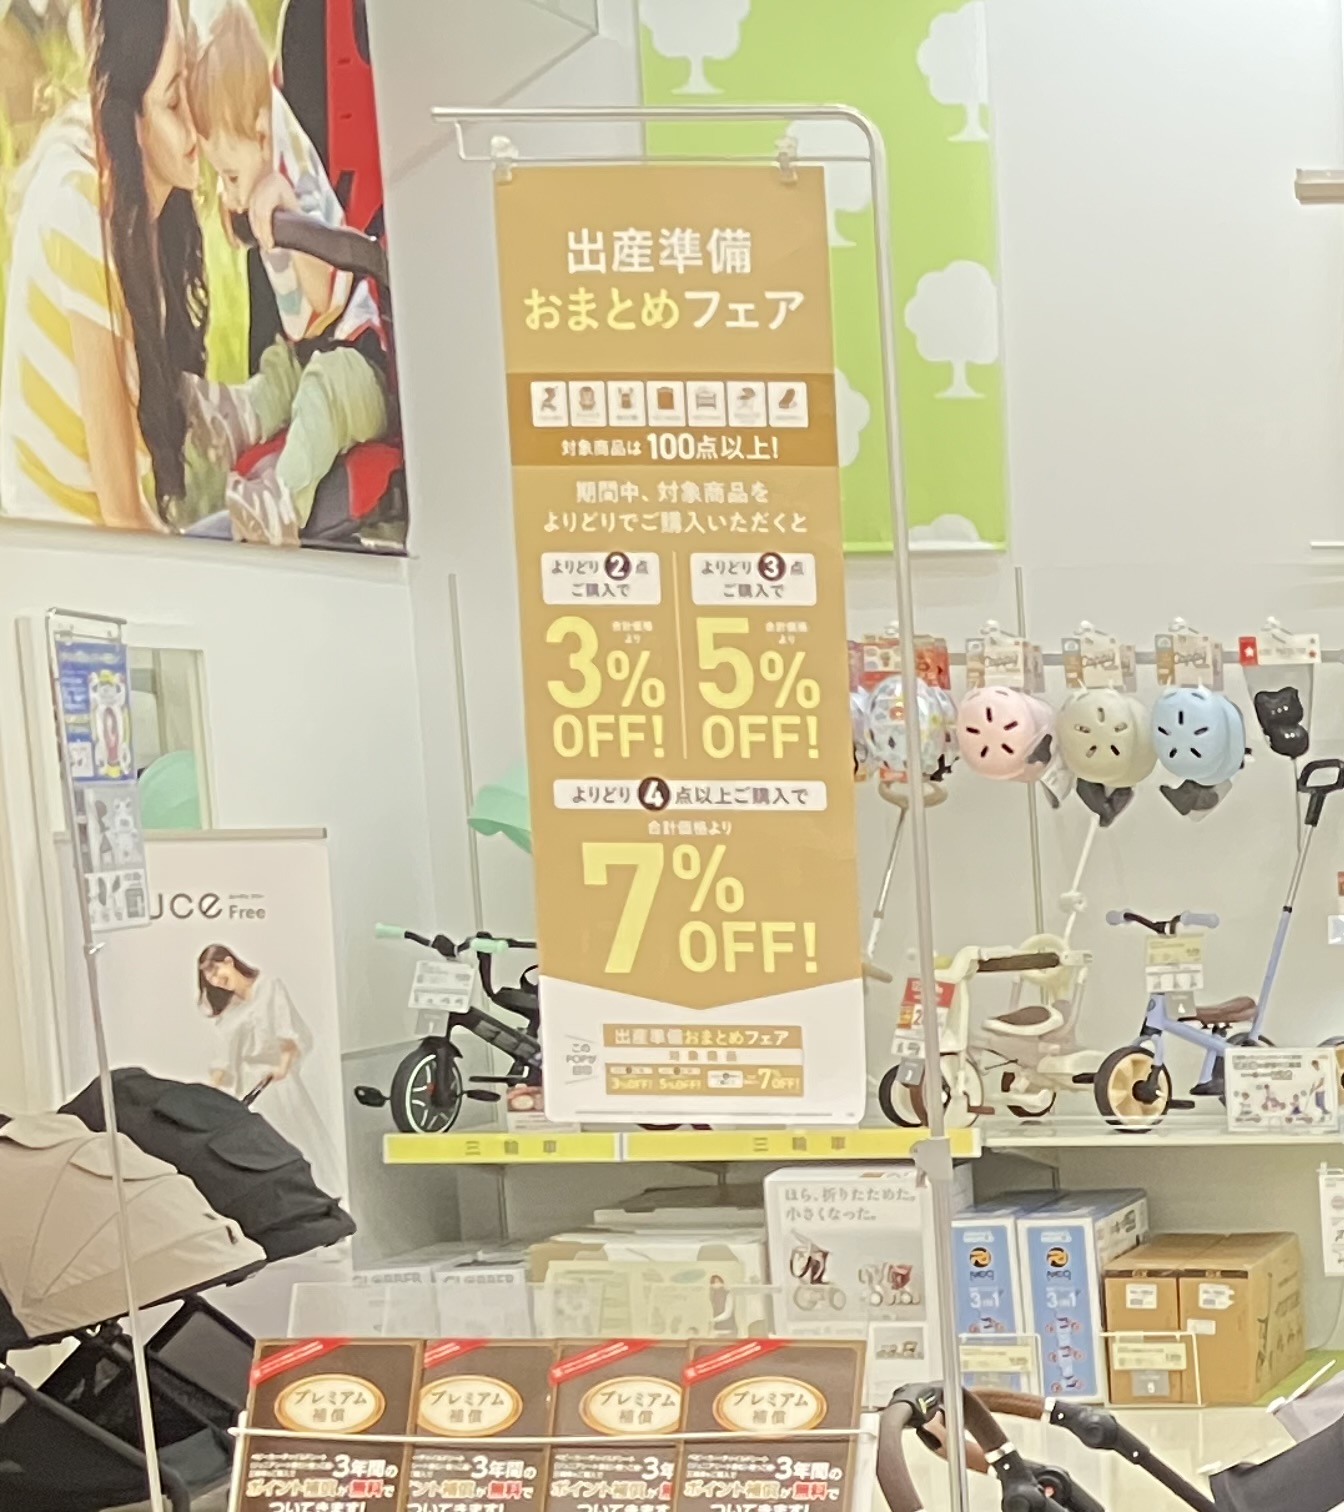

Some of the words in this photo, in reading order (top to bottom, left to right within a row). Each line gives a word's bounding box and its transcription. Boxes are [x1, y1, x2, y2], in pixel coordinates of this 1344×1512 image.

[567, 227, 752, 274] 出産準備
[523, 287, 805, 331] おまとめフェア
[647, 433, 779, 460] 100点以上!
[576, 481, 769, 504] 期間中、対象商品を
[543, 512, 808, 534] よりどりでご購入いただくと
[571, 583, 631, 598] ご購入で
[722, 584, 784, 600] ご購入で
[553, 715, 665, 759] OFF!
[702, 715, 820, 760] OFF!
[229, 905, 266, 919] Free
[679, 921, 819, 974] OFF!
[295, 1389, 367, 1405] プレミアム
[431, 1389, 504, 1405] プレミアム
[600, 1391, 676, 1407] プレミアム
[734, 1391, 809, 1407] プレミアム
[332, 1454, 398, 1478] 3年間の
[471, 1455, 537, 1480] 3年間の
[774, 1456, 842, 1481] 3年間の
